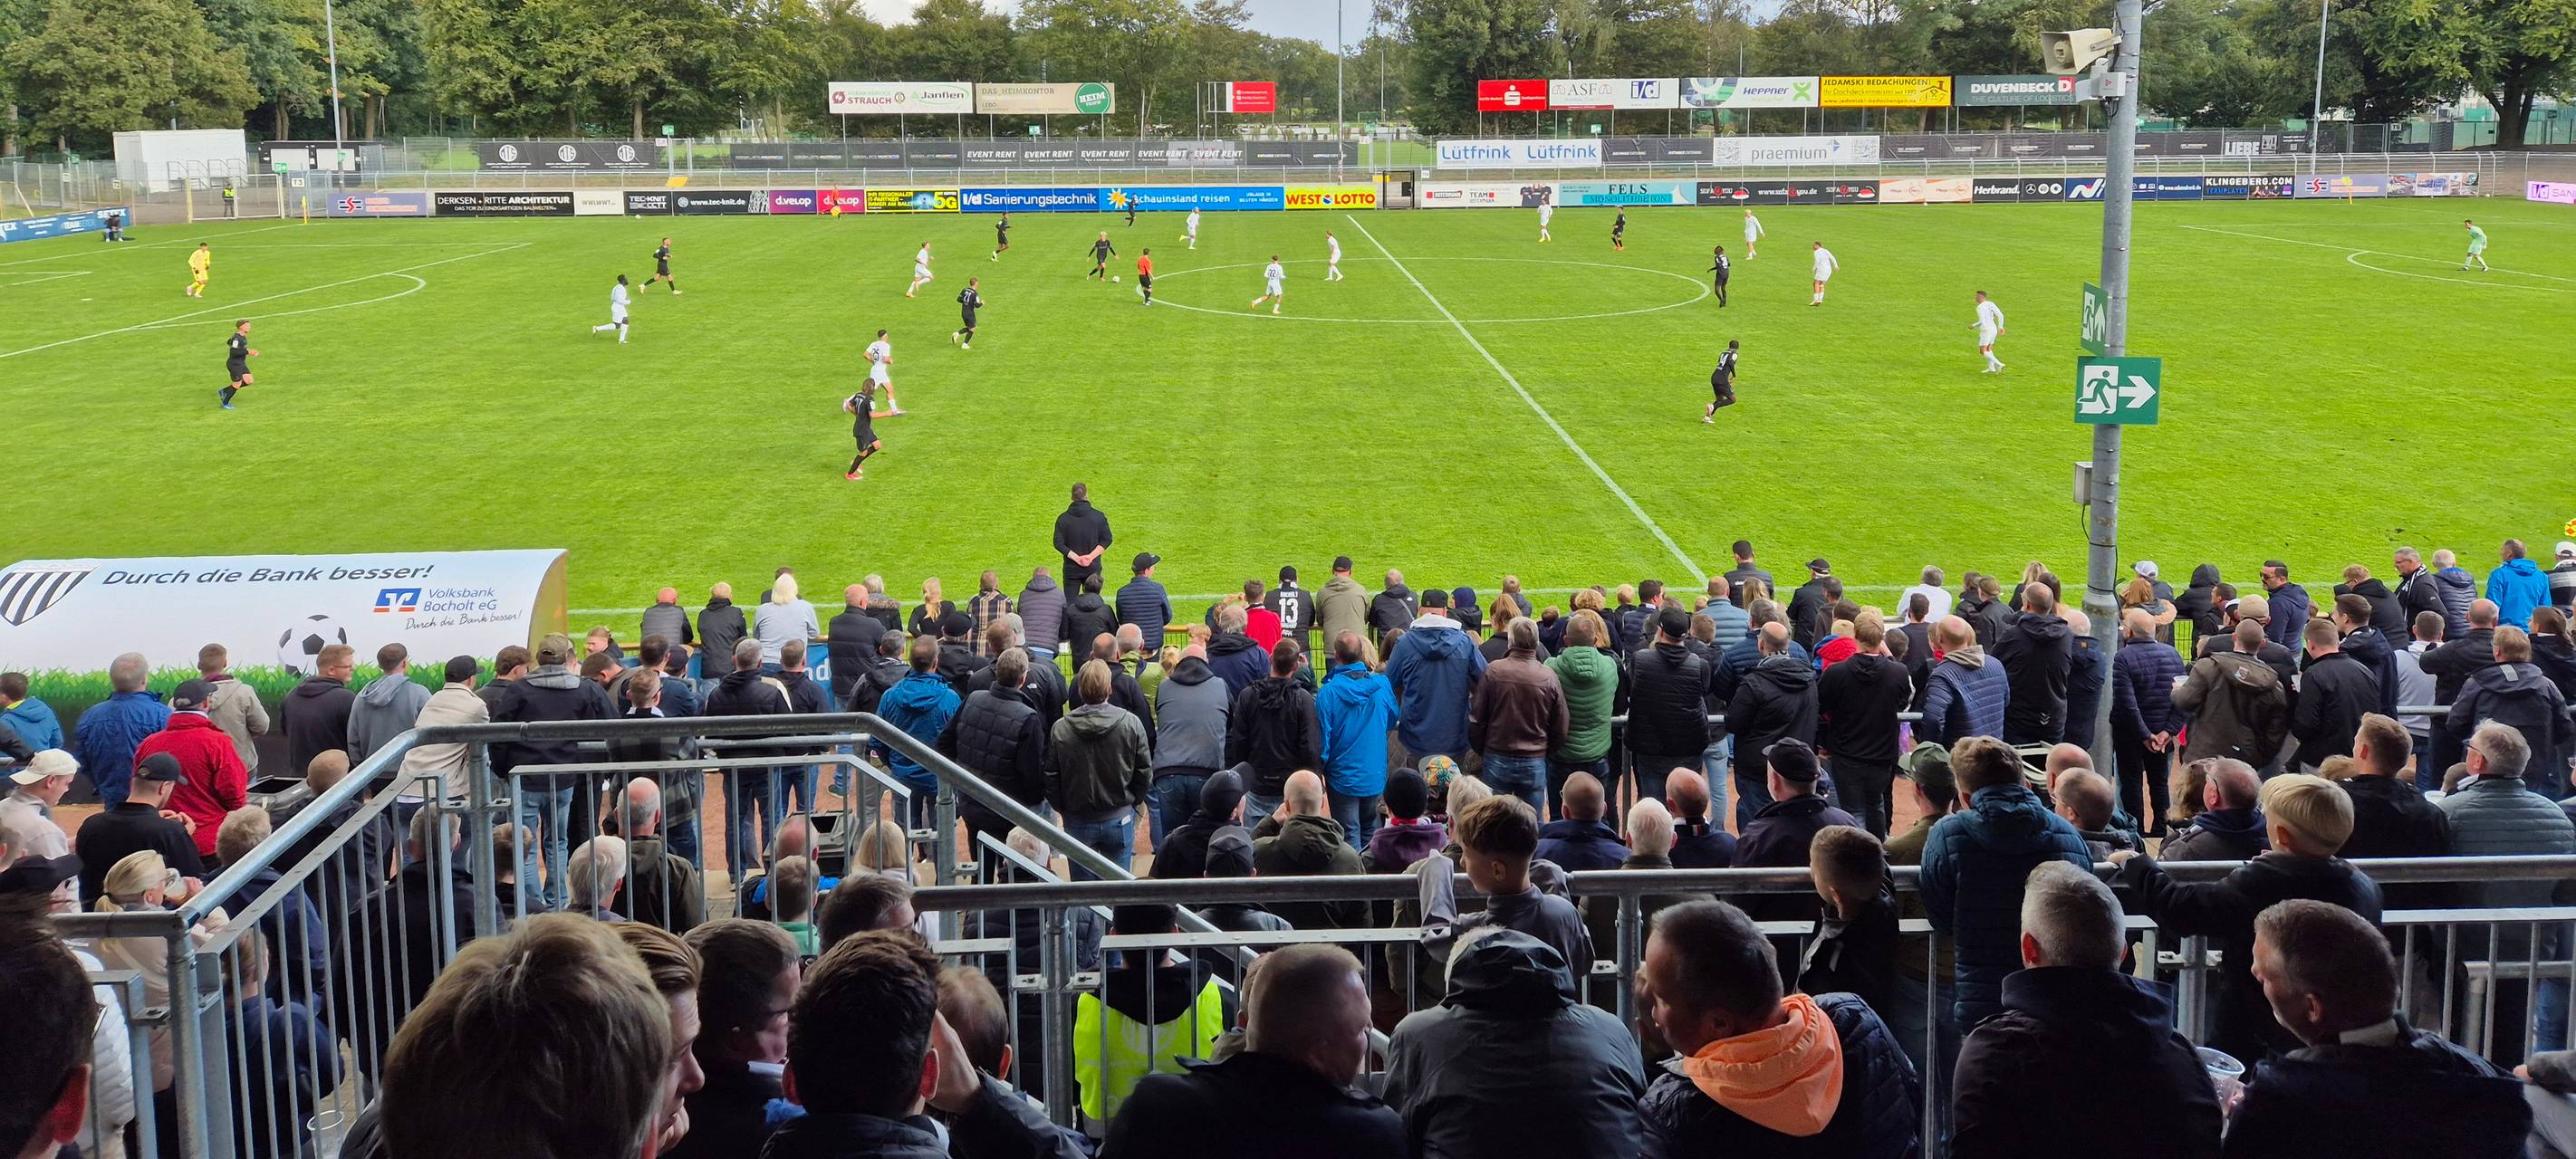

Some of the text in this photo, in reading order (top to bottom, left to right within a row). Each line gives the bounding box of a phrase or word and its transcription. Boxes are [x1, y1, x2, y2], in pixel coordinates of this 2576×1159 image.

[1567, 82, 1597, 97] ASF
[1971, 82, 2055, 94] DUVENBECK
[848, 97, 892, 105] STRAUCH
[921, 91, 965, 100] Janßen
[1079, 91, 1106, 103] HEIM
[2035, 94, 2074, 102] LOGISTICS
[1024, 150, 1051, 158] EVENT
[1138, 149, 1187, 158] EVENT RENT
[1194, 149, 1243, 158] EVENT RENT
[1441, 145, 1512, 160] Lütfrink
[1527, 144, 1597, 159] Lütfrink
[2225, 141, 2261, 156] LIEBE
[1751, 146, 1828, 163] praemium
[2206, 177, 2293, 186] KLINGEBERG.COM
[1609, 184, 1648, 195] FELS
[437, 196, 571, 205] DERKSEN RITTE ARCHITEKTUR
[690, 198, 746, 206] www.tec-knit.de
[823, 195, 860, 206] d.elop
[933, 191, 957, 209] 5G
[984, 193, 1097, 207] Sanierungstechnik
[1134, 193, 1230, 204] schauinsland reisen
[1286, 193, 1375, 205] WEST LOTTO
[1590, 195, 1668, 204] MONOLITHBETON
[102, 565, 435, 585] Durch die Bank besser!
[429, 588, 495, 599] Volksbank
[423, 599, 497, 612] Bocholt eG
[1278, 598, 1299, 624] 13
[406, 617, 437, 630] Durch
[439, 616, 455, 627] die
[458, 613, 488, 626] Bank
